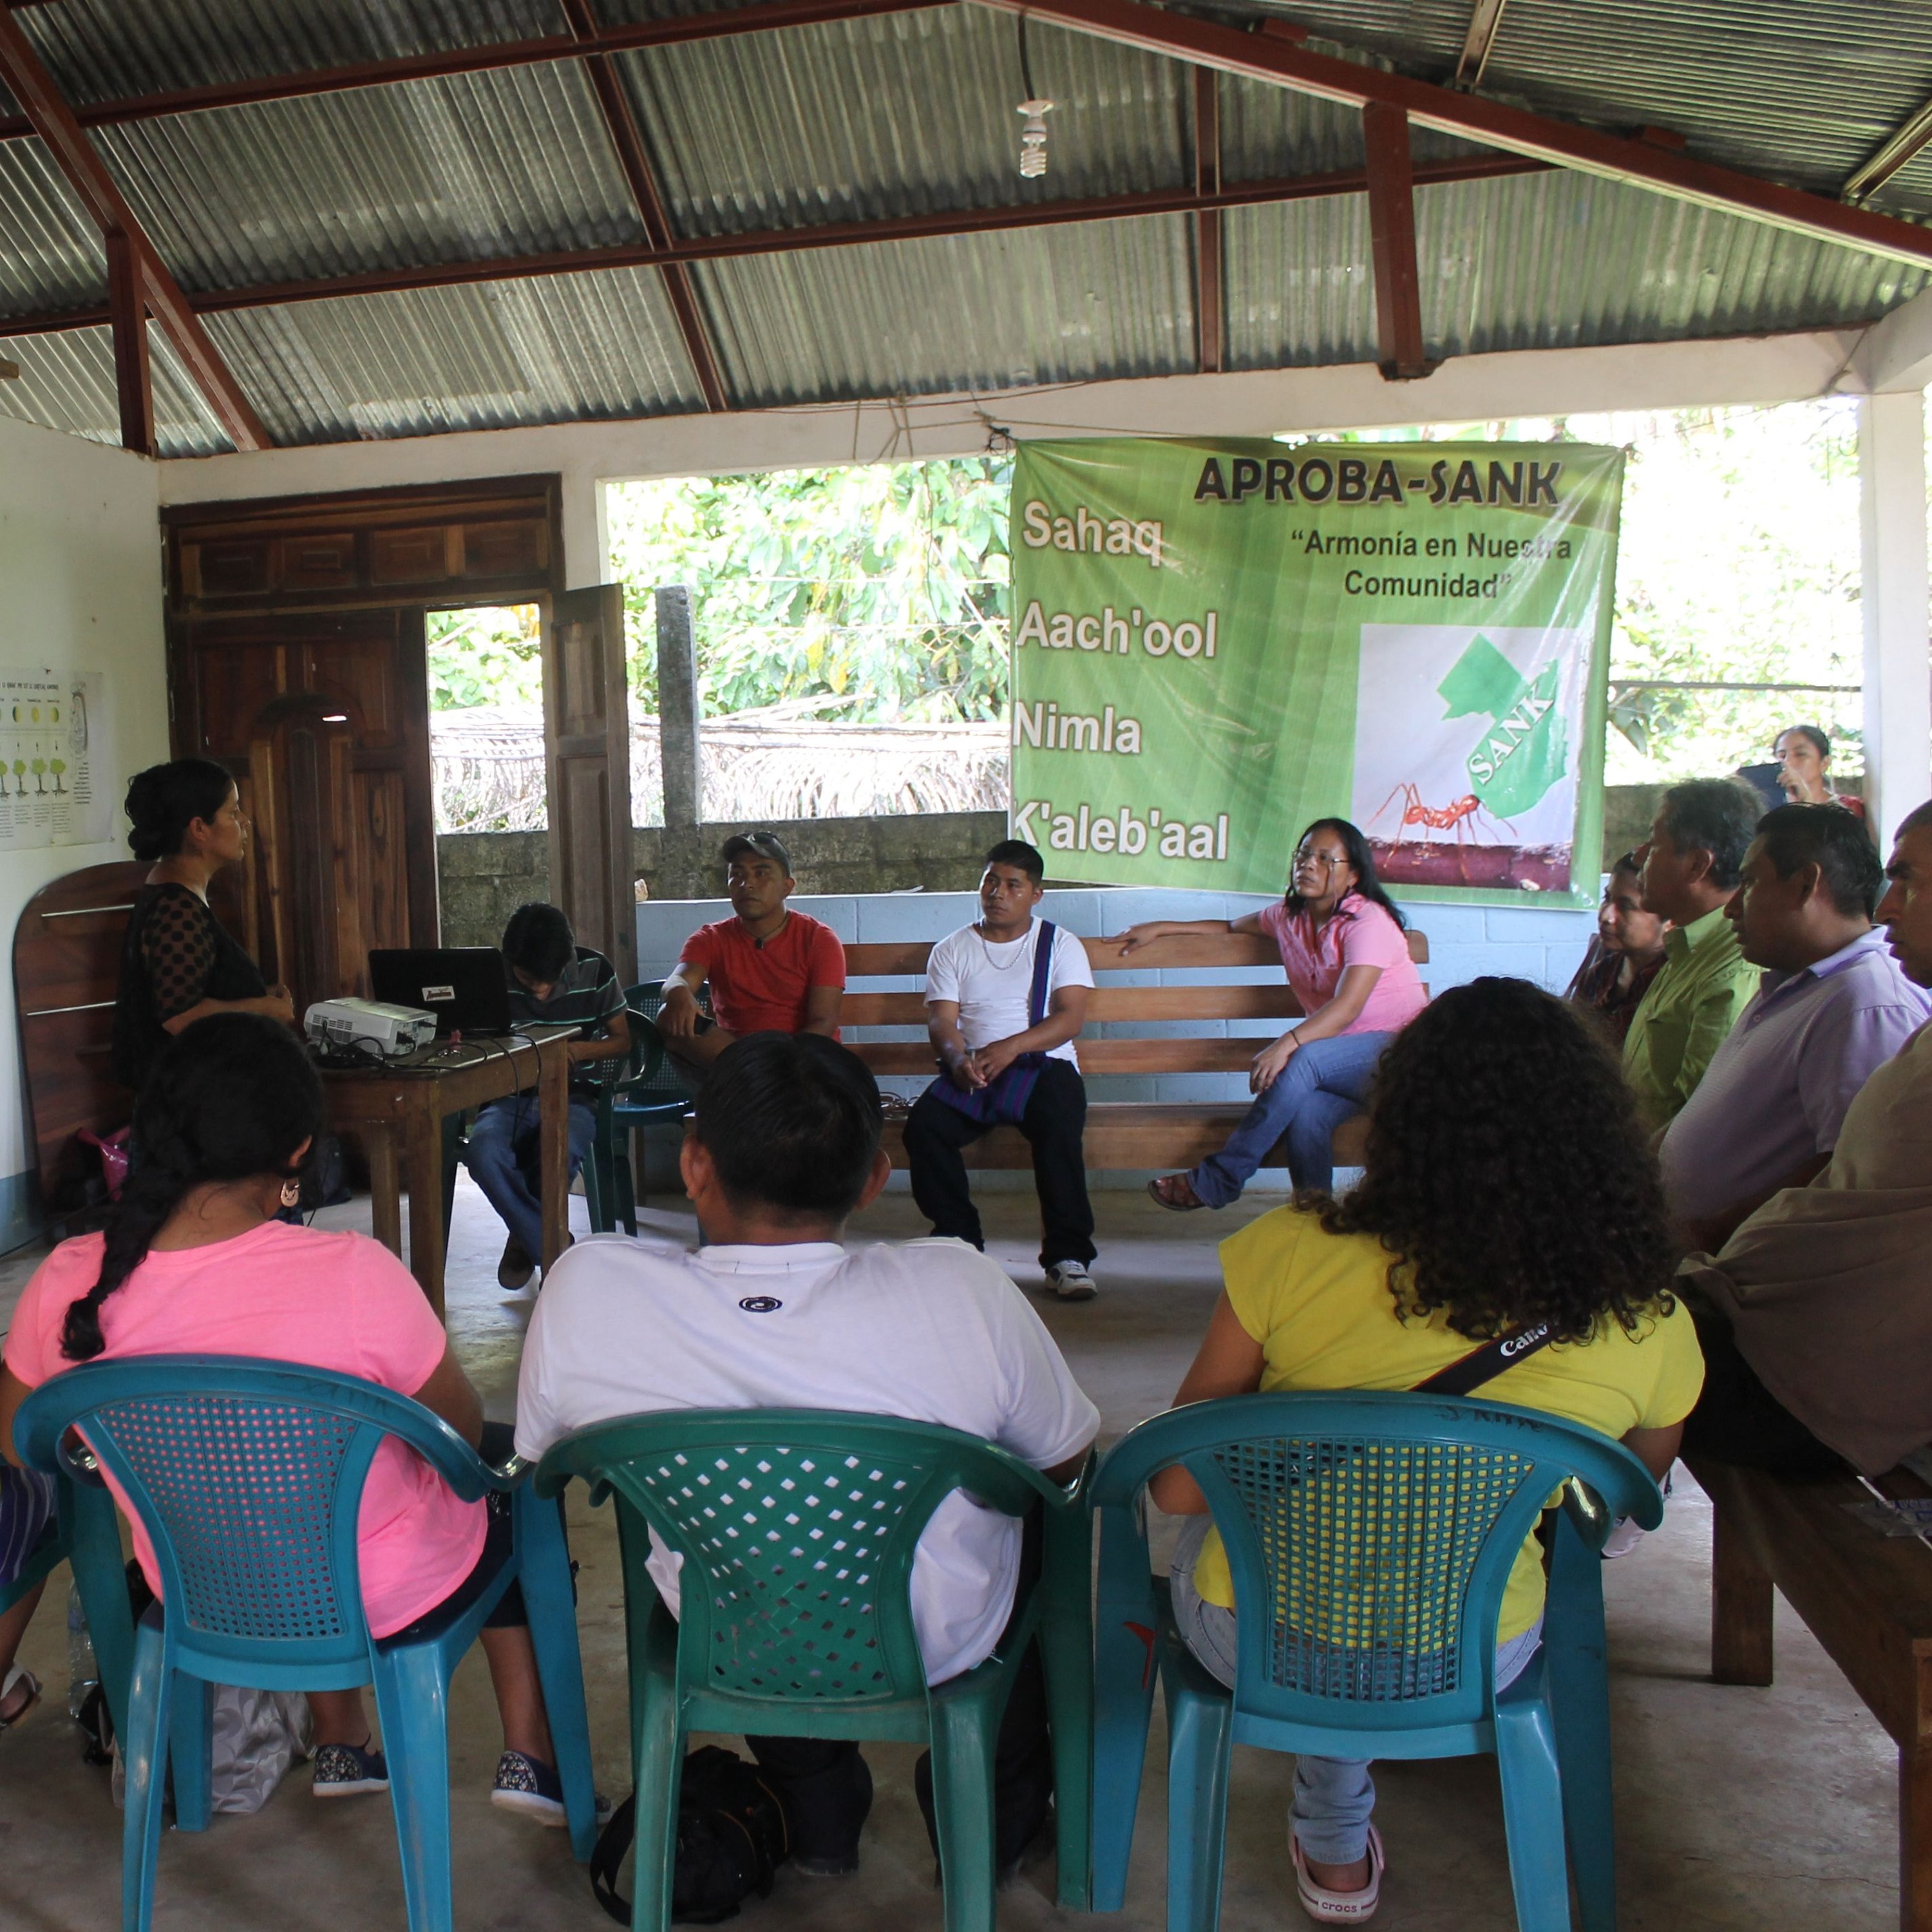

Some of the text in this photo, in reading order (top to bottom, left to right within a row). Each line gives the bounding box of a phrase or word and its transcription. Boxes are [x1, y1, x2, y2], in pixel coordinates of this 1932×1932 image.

[1193, 457, 1563, 506] APROBA-SANK
[1023, 500, 1163, 567] Sahaq
[1425, 536, 1457, 558] en
[1466, 533, 1572, 560] Nuestra
[1016, 601, 1217, 658] Aach'ool
[1012, 701, 1141, 754] Nimla
[1468, 682, 1555, 786] SANK
[1014, 800, 1229, 861] K'aleb'aal
[1500, 1320, 1552, 1357] Cano
[1321, 1902, 1358, 1913] crocs
